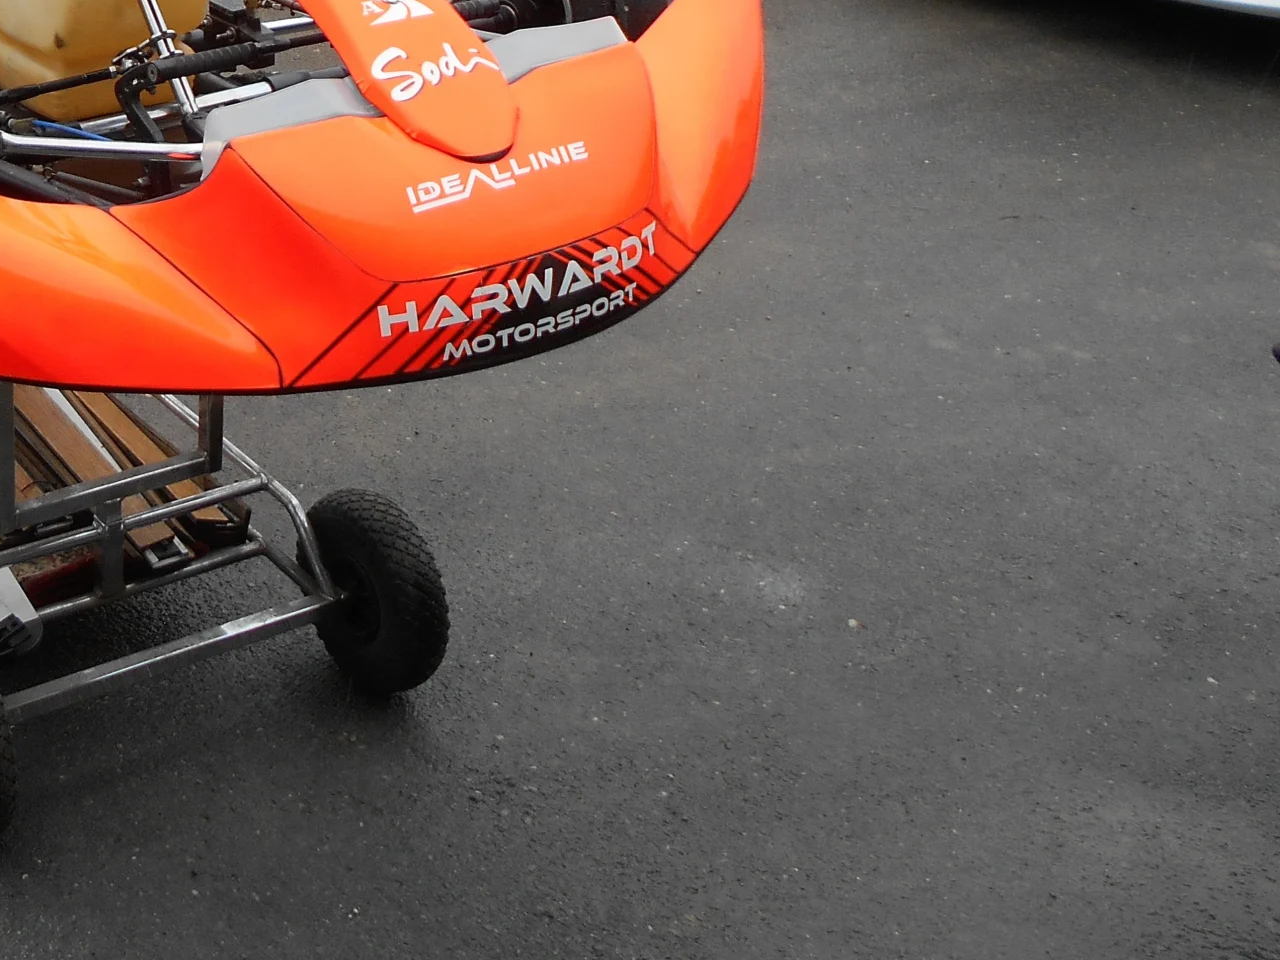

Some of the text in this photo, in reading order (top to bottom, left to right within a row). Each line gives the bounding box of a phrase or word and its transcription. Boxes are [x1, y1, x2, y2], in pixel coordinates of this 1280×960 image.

[371, 42, 499, 102] Sodi
[405, 141, 589, 213] IDEALLINIE
[377, 221, 657, 337] HARWARDT
[443, 282, 636, 361] MOTORSPORT
